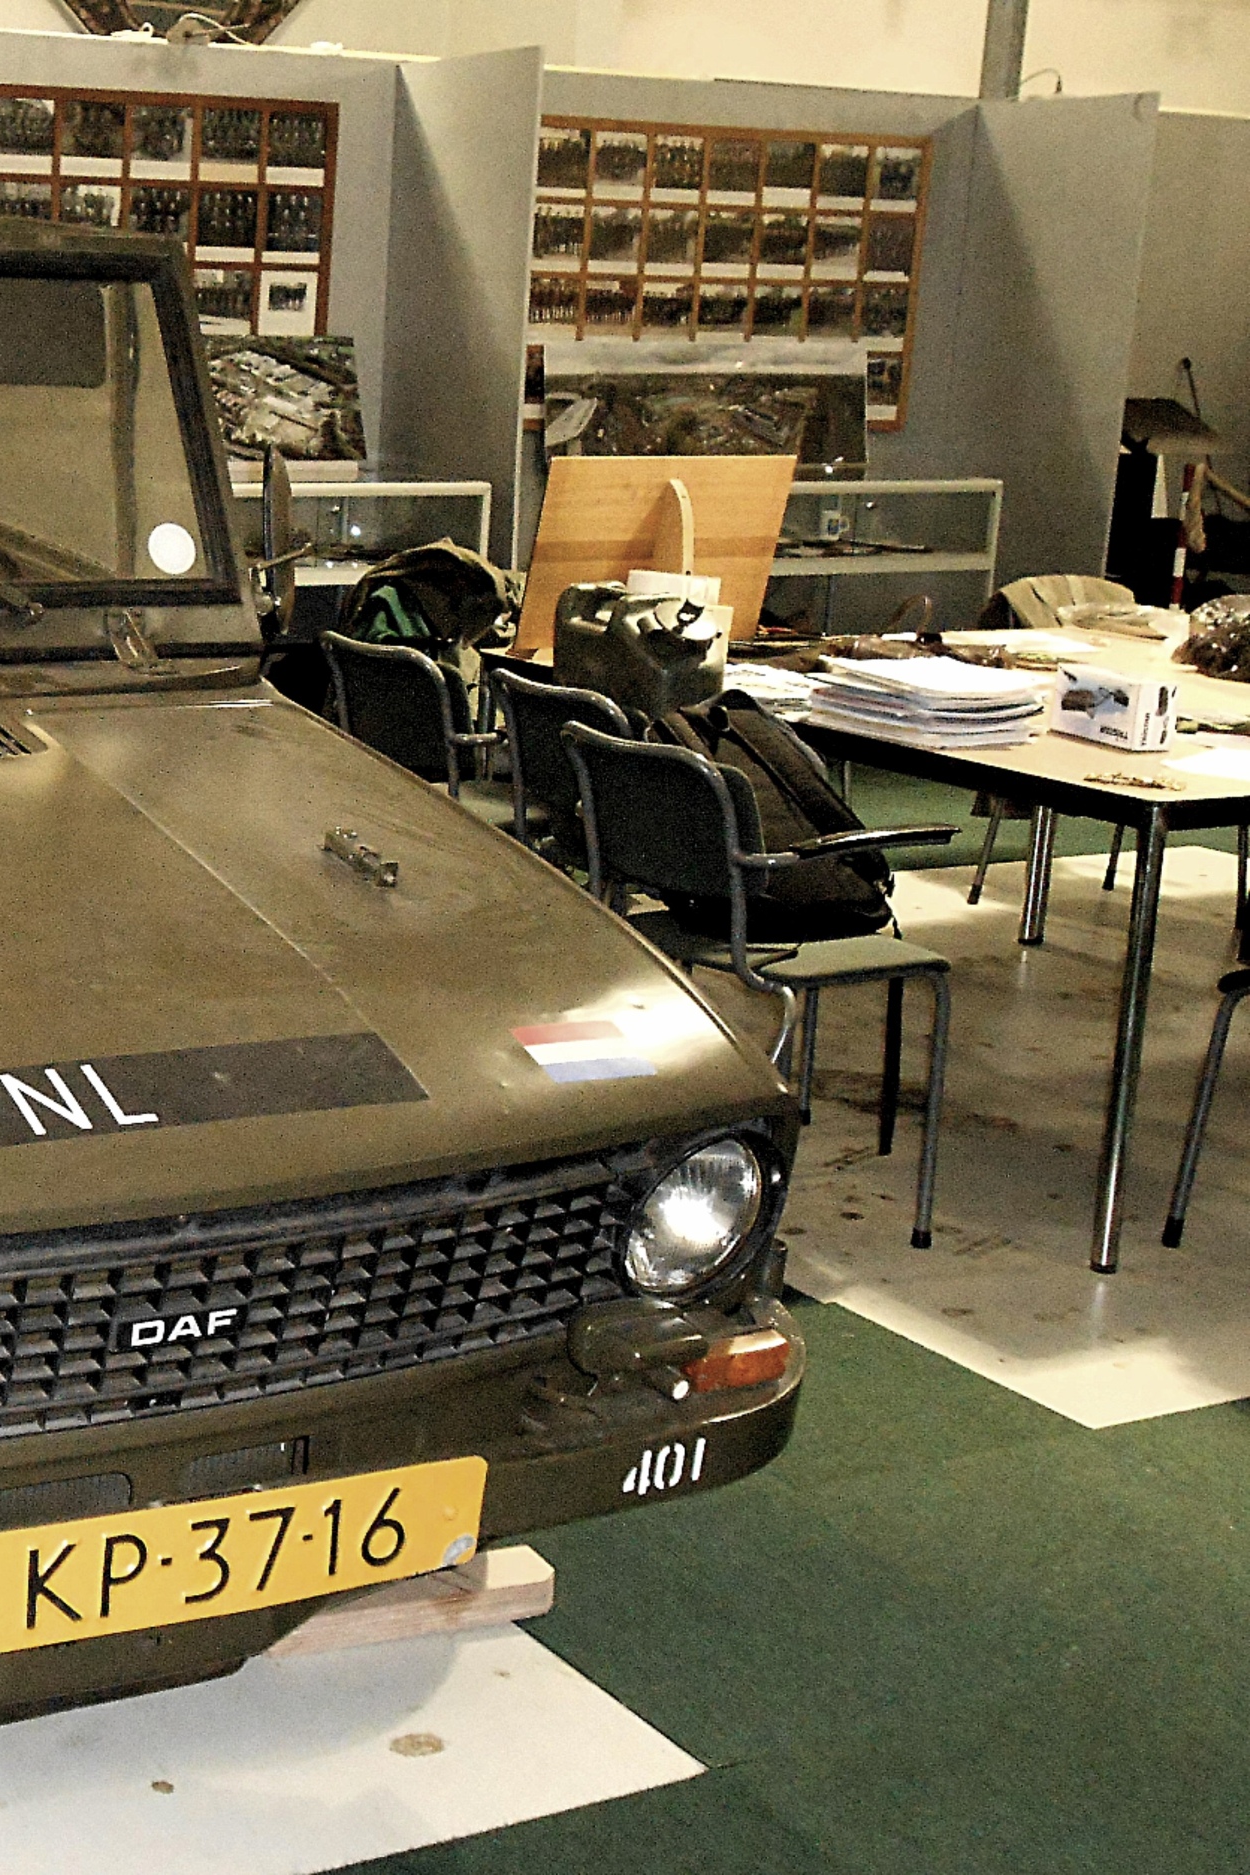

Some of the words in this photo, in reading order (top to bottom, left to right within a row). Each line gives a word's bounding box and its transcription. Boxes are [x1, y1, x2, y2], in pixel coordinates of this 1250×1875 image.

[131, 1308, 238, 1347] DAF
[622, 1437, 706, 1496] 401
[27, 1487, 406, 1629] KP-37-16
